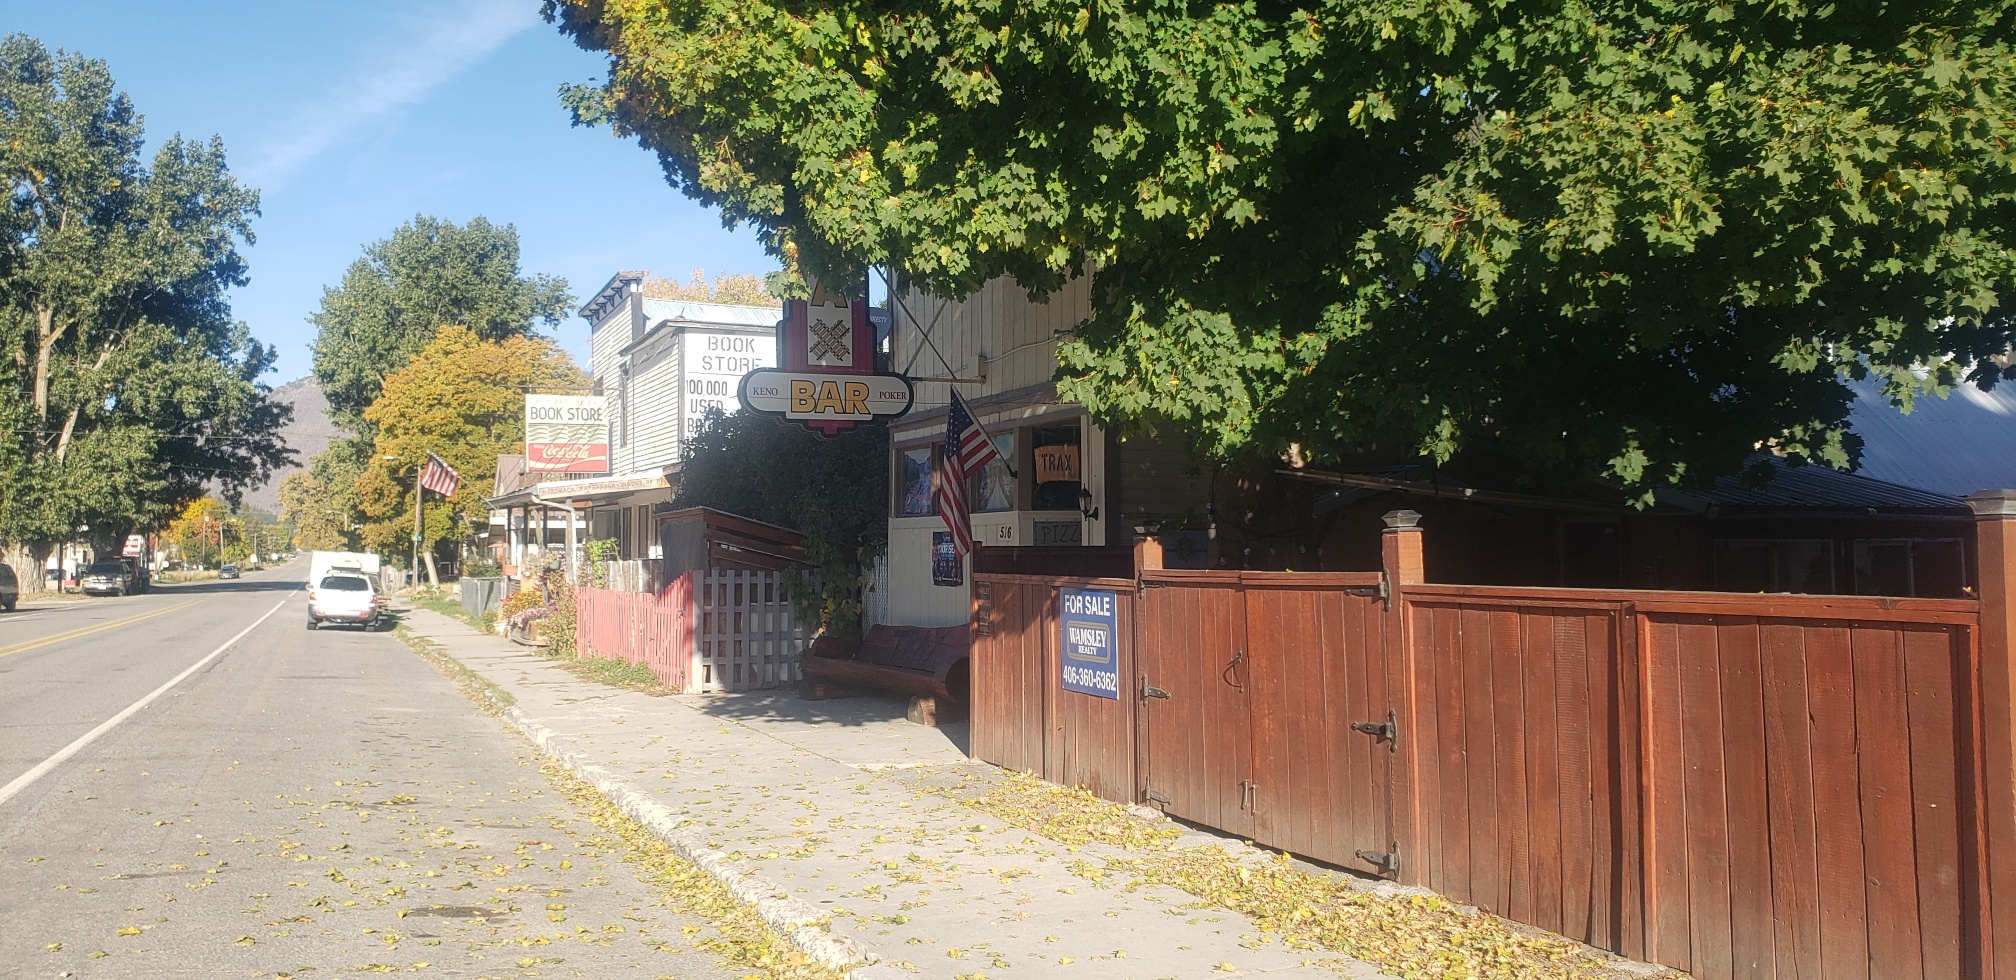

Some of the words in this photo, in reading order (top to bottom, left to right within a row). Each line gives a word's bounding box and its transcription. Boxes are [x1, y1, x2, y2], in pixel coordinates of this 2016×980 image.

[708, 336, 755, 353] BOOK
[702, 356, 762, 372] STORE
[753, 387, 778, 396] KENO
[790, 379, 871, 415] BAR
[879, 391, 907, 400] POKER
[530, 406, 563, 421] BOOK
[567, 407, 603, 422] STORE
[1041, 453, 1071, 472] TRAX
[999, 526, 1012, 539] 516
[1064, 594, 1083, 614] FOR
[1085, 595, 1110, 617] SALE
[1069, 627, 1107, 648] WAMSLEY
[1078, 645, 1097, 655] REALTY
[1063, 665, 1116, 692] 406-360-6362
